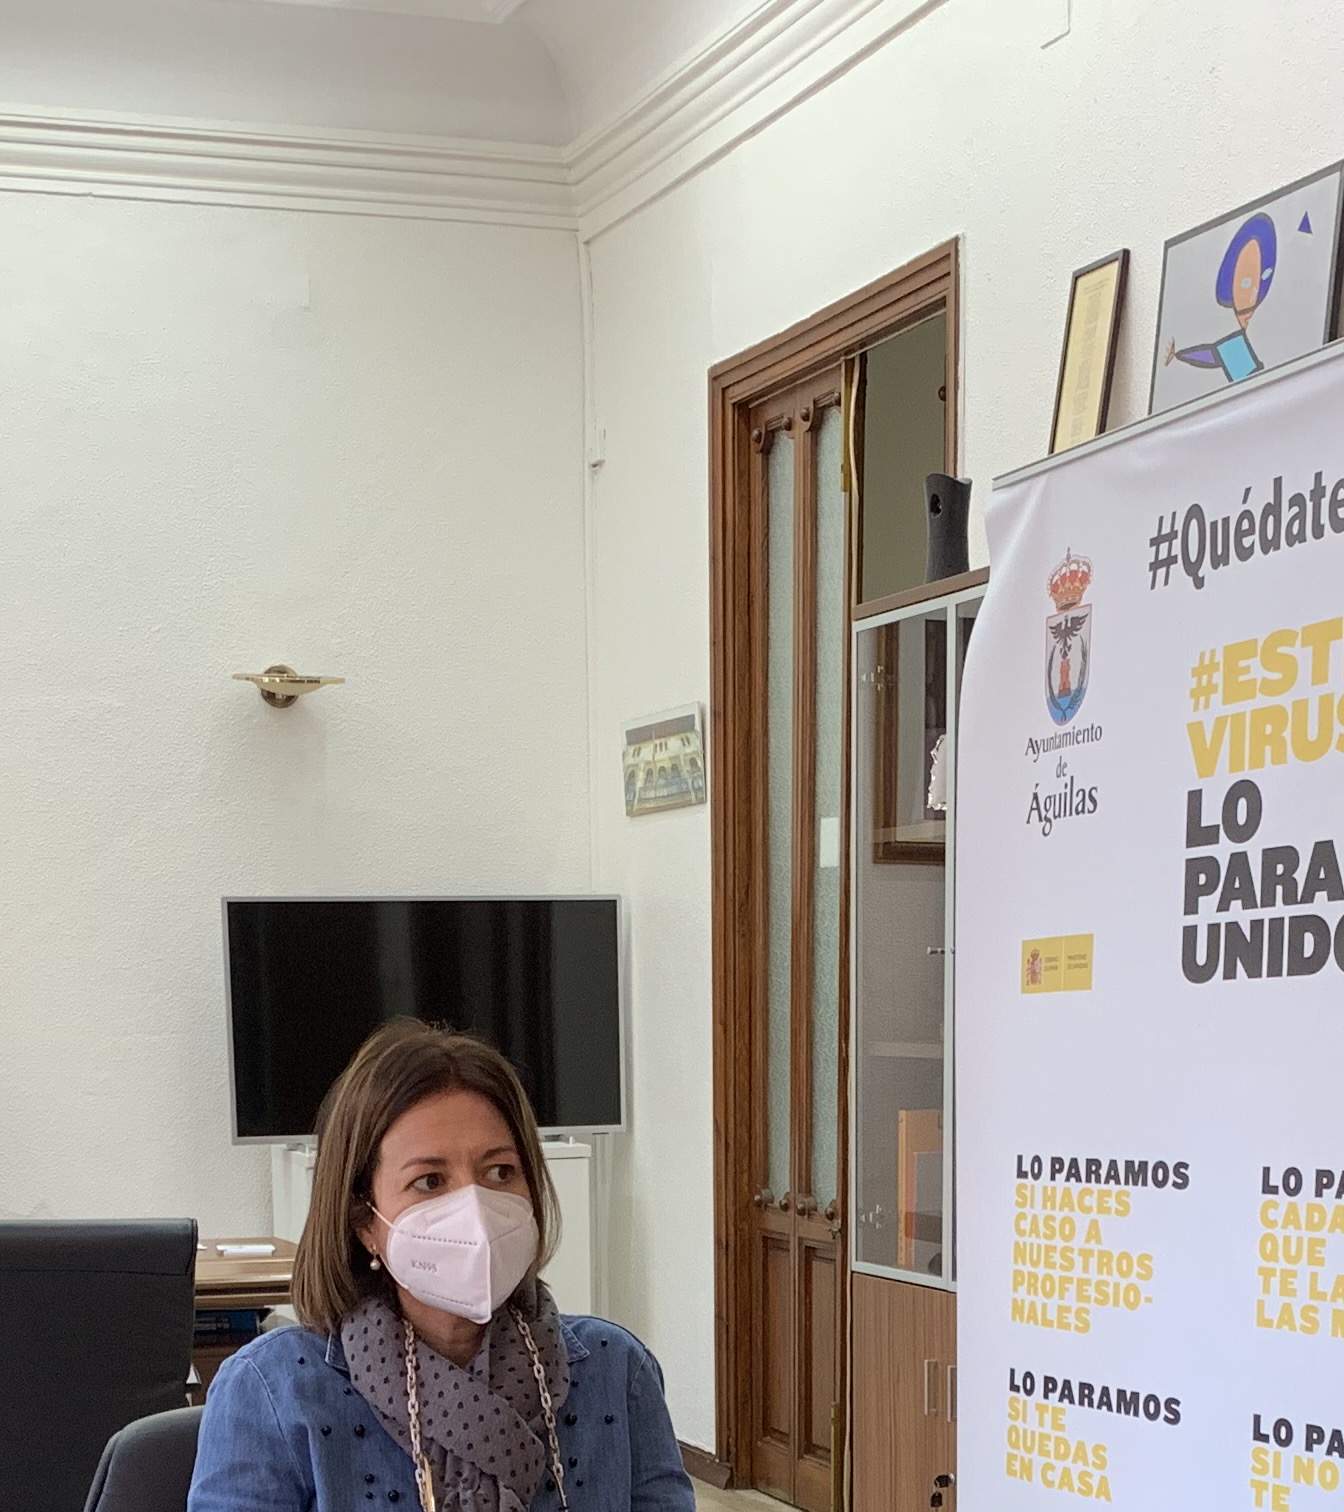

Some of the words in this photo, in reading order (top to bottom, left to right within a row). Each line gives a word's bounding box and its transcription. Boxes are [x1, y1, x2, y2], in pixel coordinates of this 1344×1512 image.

[1024, 722, 1103, 763] Ayuntamiento
[1056, 755, 1068, 779] de
[1025, 775, 1099, 837] Águilas
[1185, 778, 1263, 849] LO
[1016, 1154, 1043, 1181] LO
[1049, 1156, 1190, 1190] PARAMOS
[1261, 1166, 1303, 1198] LO
[1014, 1183, 1035, 1210] SI
[1041, 1186, 1131, 1217] HACES
[1013, 1213, 1077, 1243] CASO
[1084, 1218, 1102, 1245] A
[1012, 1241, 1154, 1281] NUESTROS
[1258, 1232, 1327, 1267] QUE
[1011, 1269, 1154, 1311] PROFESIO-
[1257, 1266, 1298, 1298] TE
[1011, 1299, 1091, 1334] NALES
[1256, 1299, 1320, 1335] LAS
[1007, 1396, 1028, 1423] SI
[1034, 1403, 1066, 1433] TE
[1009, 1367, 1036, 1397] LO
[1042, 1375, 1181, 1426] PARAMOS
[1006, 1425, 1108, 1471] QUEDAS
[1252, 1413, 1294, 1448] LO
[1005, 1452, 1034, 1482] EN
[1040, 1461, 1112, 1503] CASA
[1250, 1446, 1282, 1480] SI
[1293, 1455, 1340, 1491] NO
